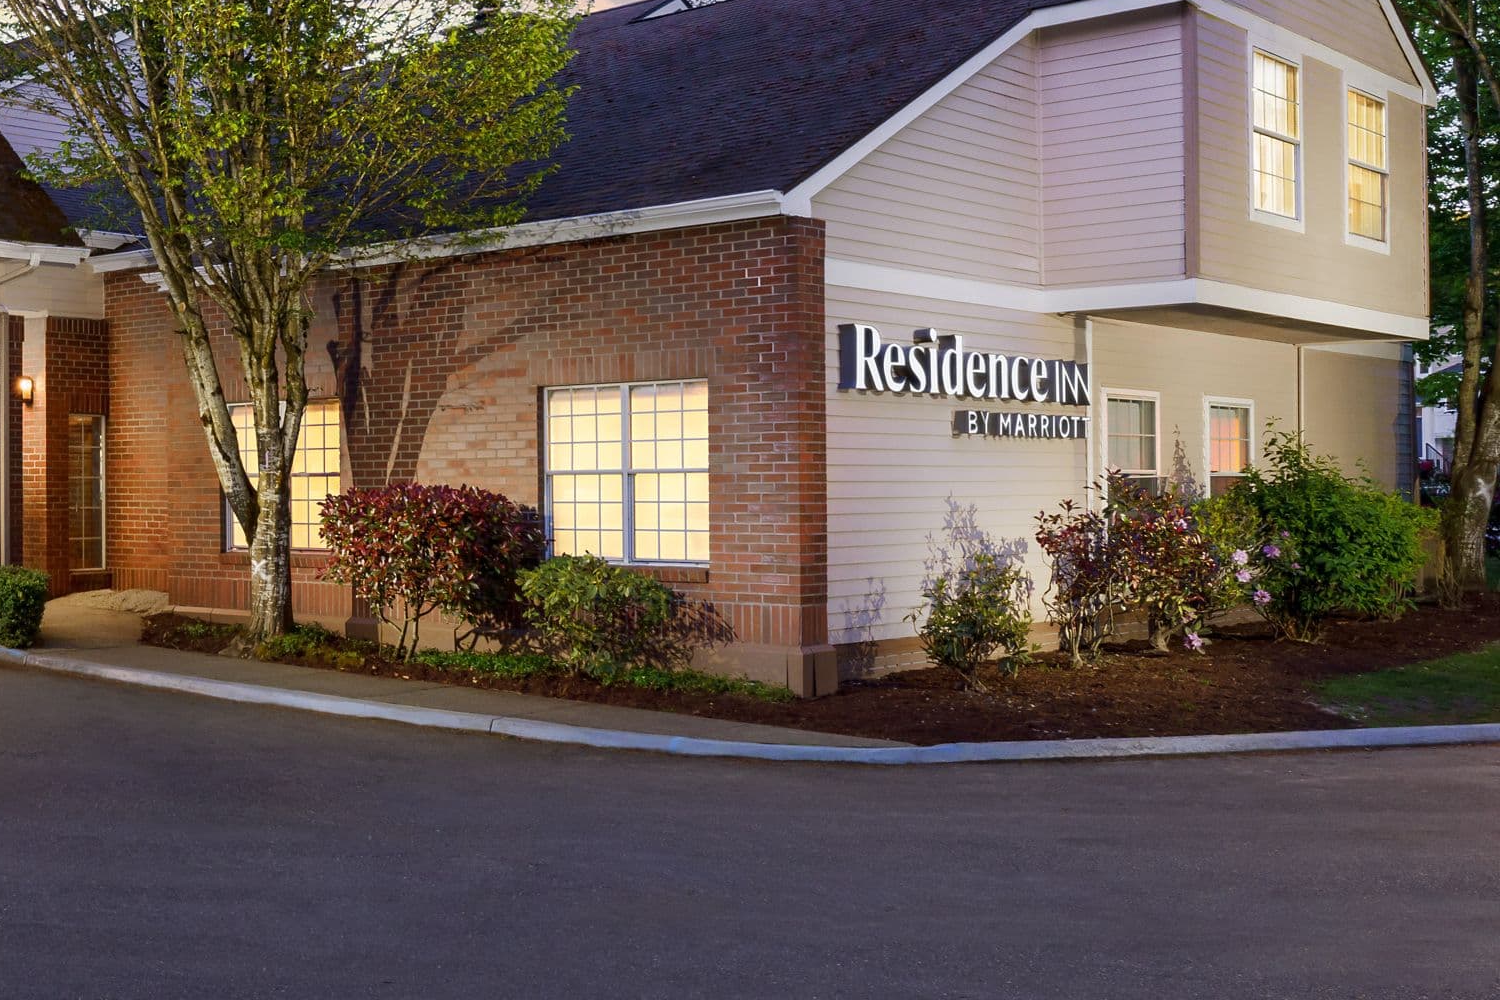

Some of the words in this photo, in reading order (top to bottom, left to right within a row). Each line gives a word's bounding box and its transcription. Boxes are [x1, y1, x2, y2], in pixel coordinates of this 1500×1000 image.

[854, 323, 1048, 402] Residence
[1055, 361, 1091, 405] INN
[968, 411, 990, 434] BY
[999, 413, 1091, 438] MARRIOTT
